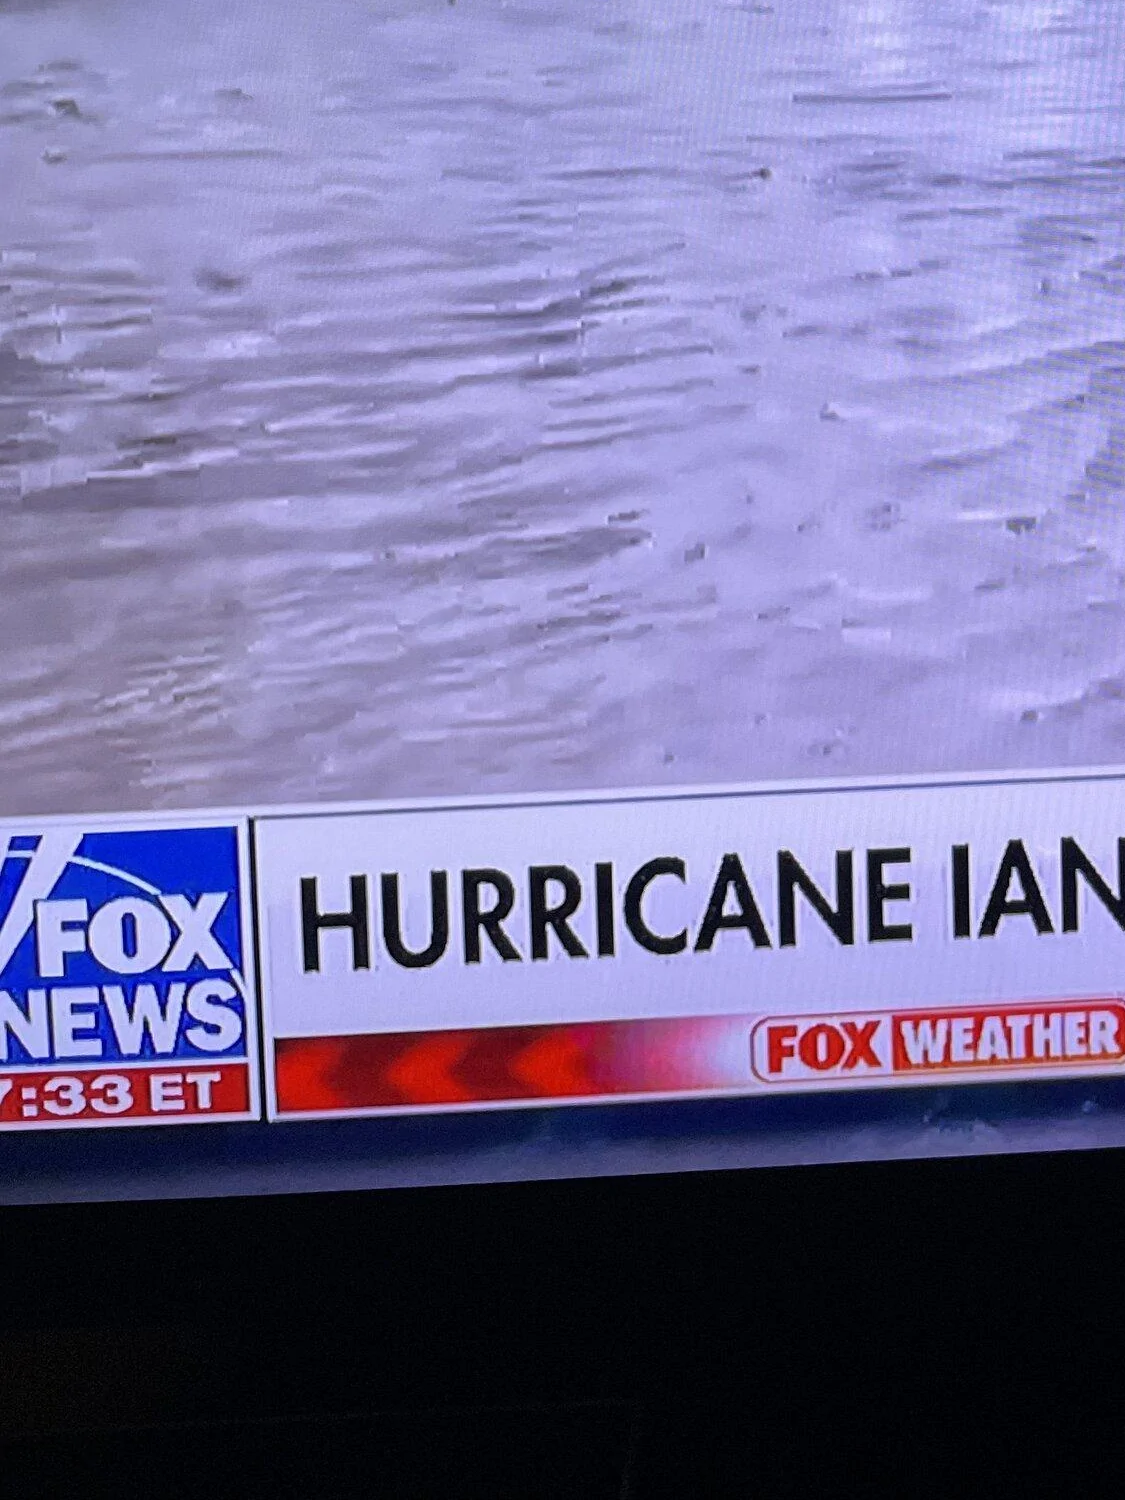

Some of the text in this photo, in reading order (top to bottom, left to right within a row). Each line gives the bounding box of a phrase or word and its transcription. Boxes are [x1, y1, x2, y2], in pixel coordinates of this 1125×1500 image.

[37, 892, 233, 977] FOX
[300, 846, 912, 972] HURRICANE
[0, 979, 243, 1062] NEWS
[766, 1006, 1122, 1074] FOX WEATHER
[150, 1073, 221, 1111] ET
